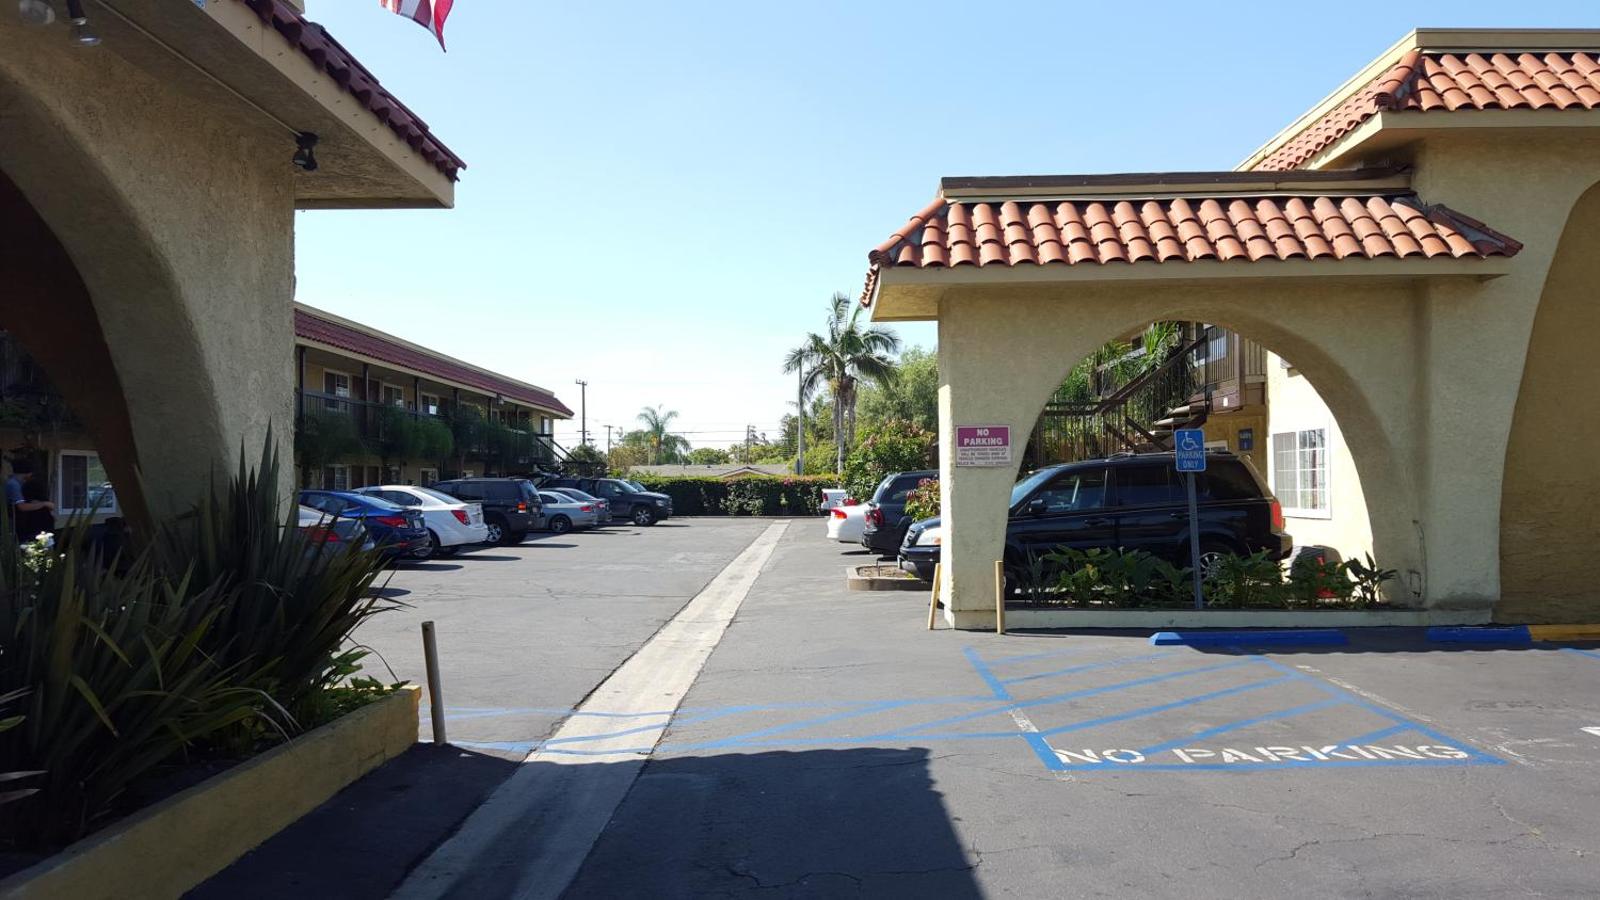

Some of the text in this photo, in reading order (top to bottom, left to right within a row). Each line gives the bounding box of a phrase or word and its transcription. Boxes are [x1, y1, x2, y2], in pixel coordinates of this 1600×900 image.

[976, 428, 990, 437] NO
[963, 437, 1003, 446] PARKING
[1177, 451, 1203, 460] PARKING
[1182, 460, 1199, 469] ONLY
[1052, 745, 1469, 764] NO PARKING
